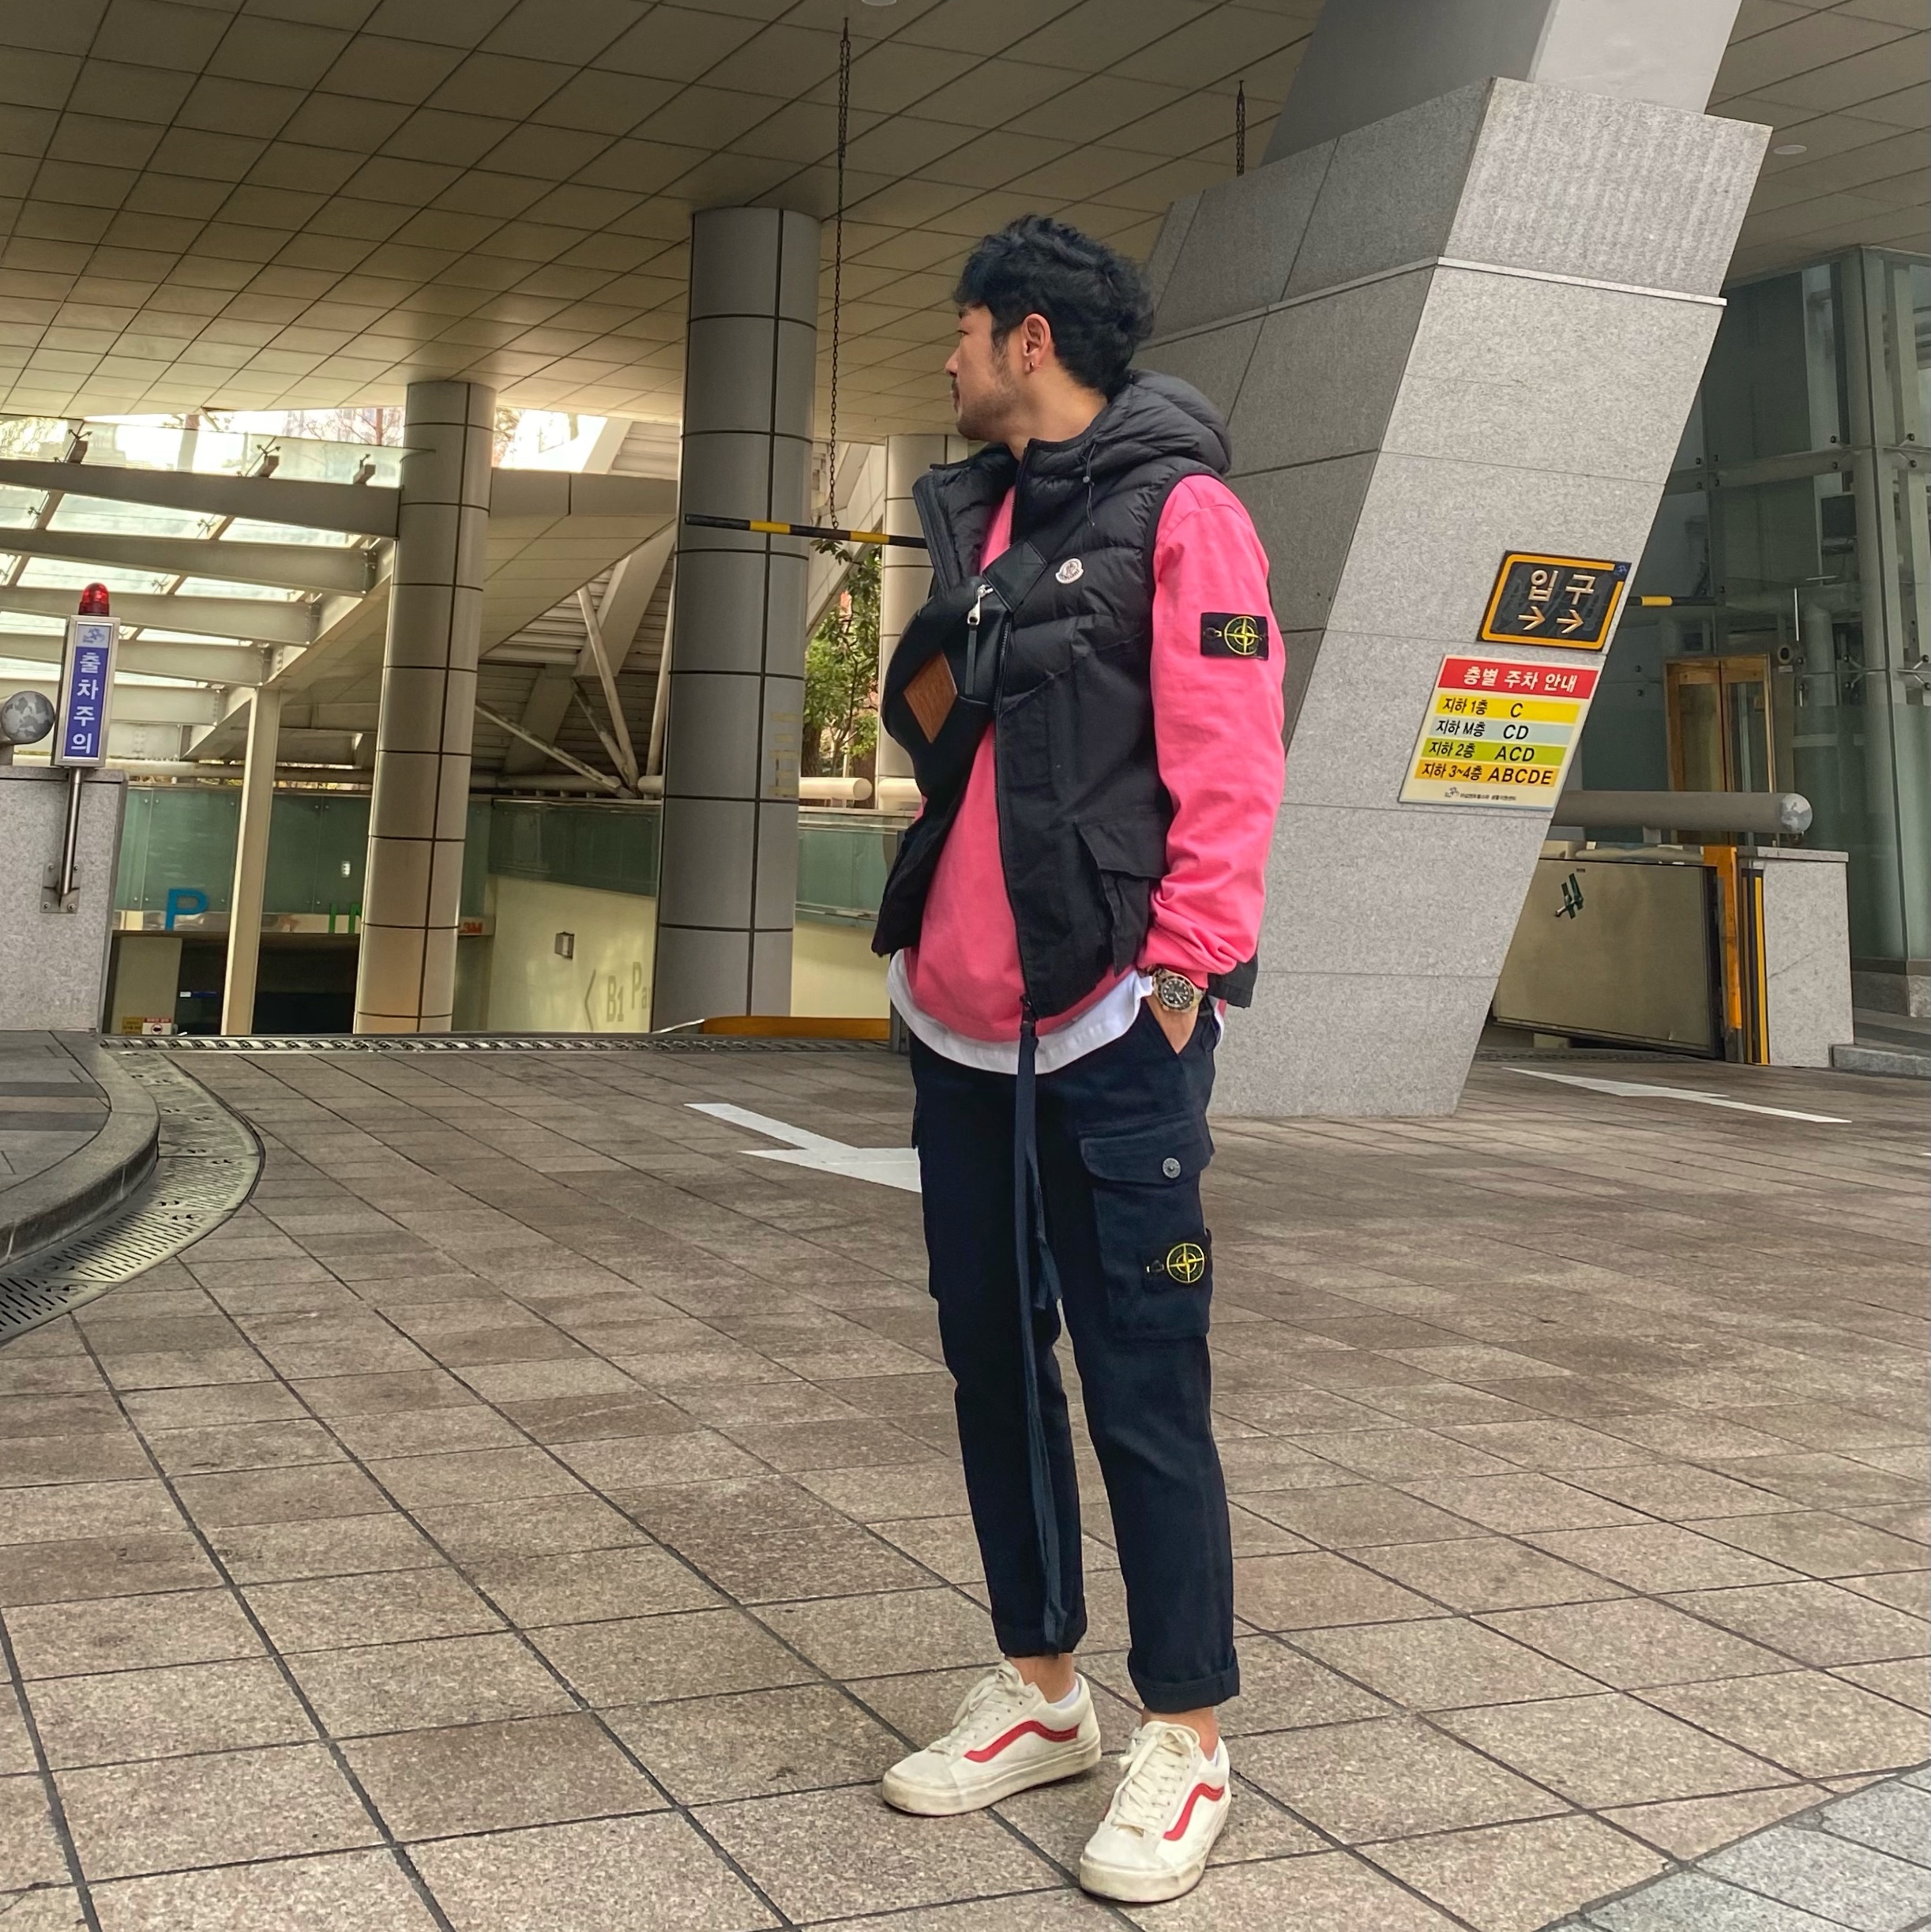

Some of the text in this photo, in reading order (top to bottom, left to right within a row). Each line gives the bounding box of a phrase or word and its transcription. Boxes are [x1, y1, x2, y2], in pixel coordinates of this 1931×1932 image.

[1528, 569, 1596, 605] 입구
[1463, 666, 1578, 693] 층별 주차 안내
[1442, 697, 1489, 716] 지하 1층
[1510, 702, 1523, 718] C
[1435, 719, 1486, 738] 지하 M층
[1503, 724, 1529, 740] CD
[1428, 740, 1476, 758] 지하 2층
[1494, 746, 1535, 762] ACD
[1421, 762, 1482, 781] 지하 3~4층
[1487, 767, 1554, 784] ABCDE
[164, 889, 208, 931] P
